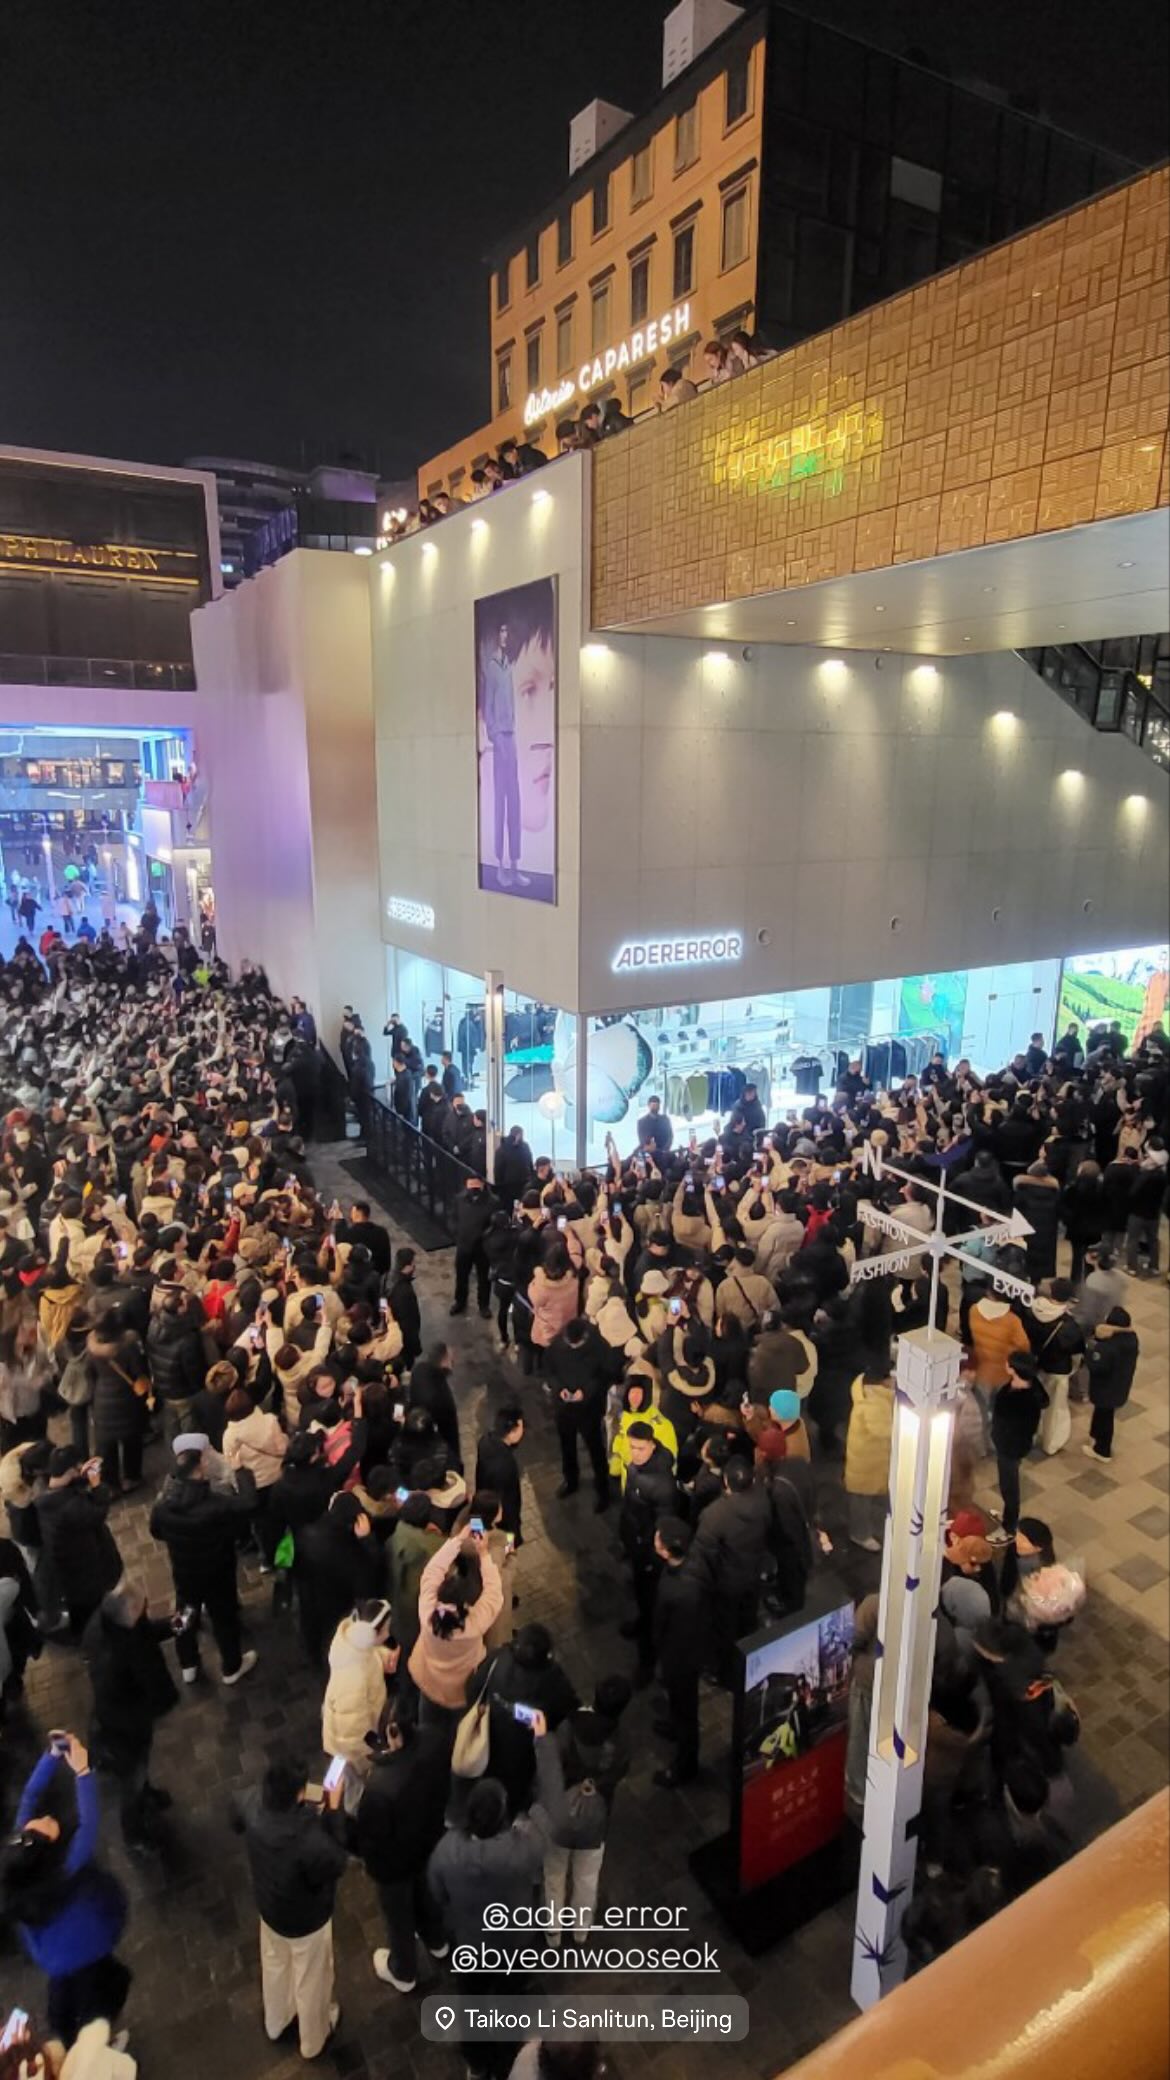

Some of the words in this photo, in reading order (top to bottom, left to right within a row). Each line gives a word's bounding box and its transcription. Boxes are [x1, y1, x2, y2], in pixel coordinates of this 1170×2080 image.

[578, 302, 691, 391] CAPARESH
[54, 541, 158, 571] LAUREN
[614, 935, 742, 970] ADERERROR
[856, 1205, 909, 1246] FASHION
[850, 1254, 911, 1285] FASHION
[992, 1276, 1035, 1308] EXPO
